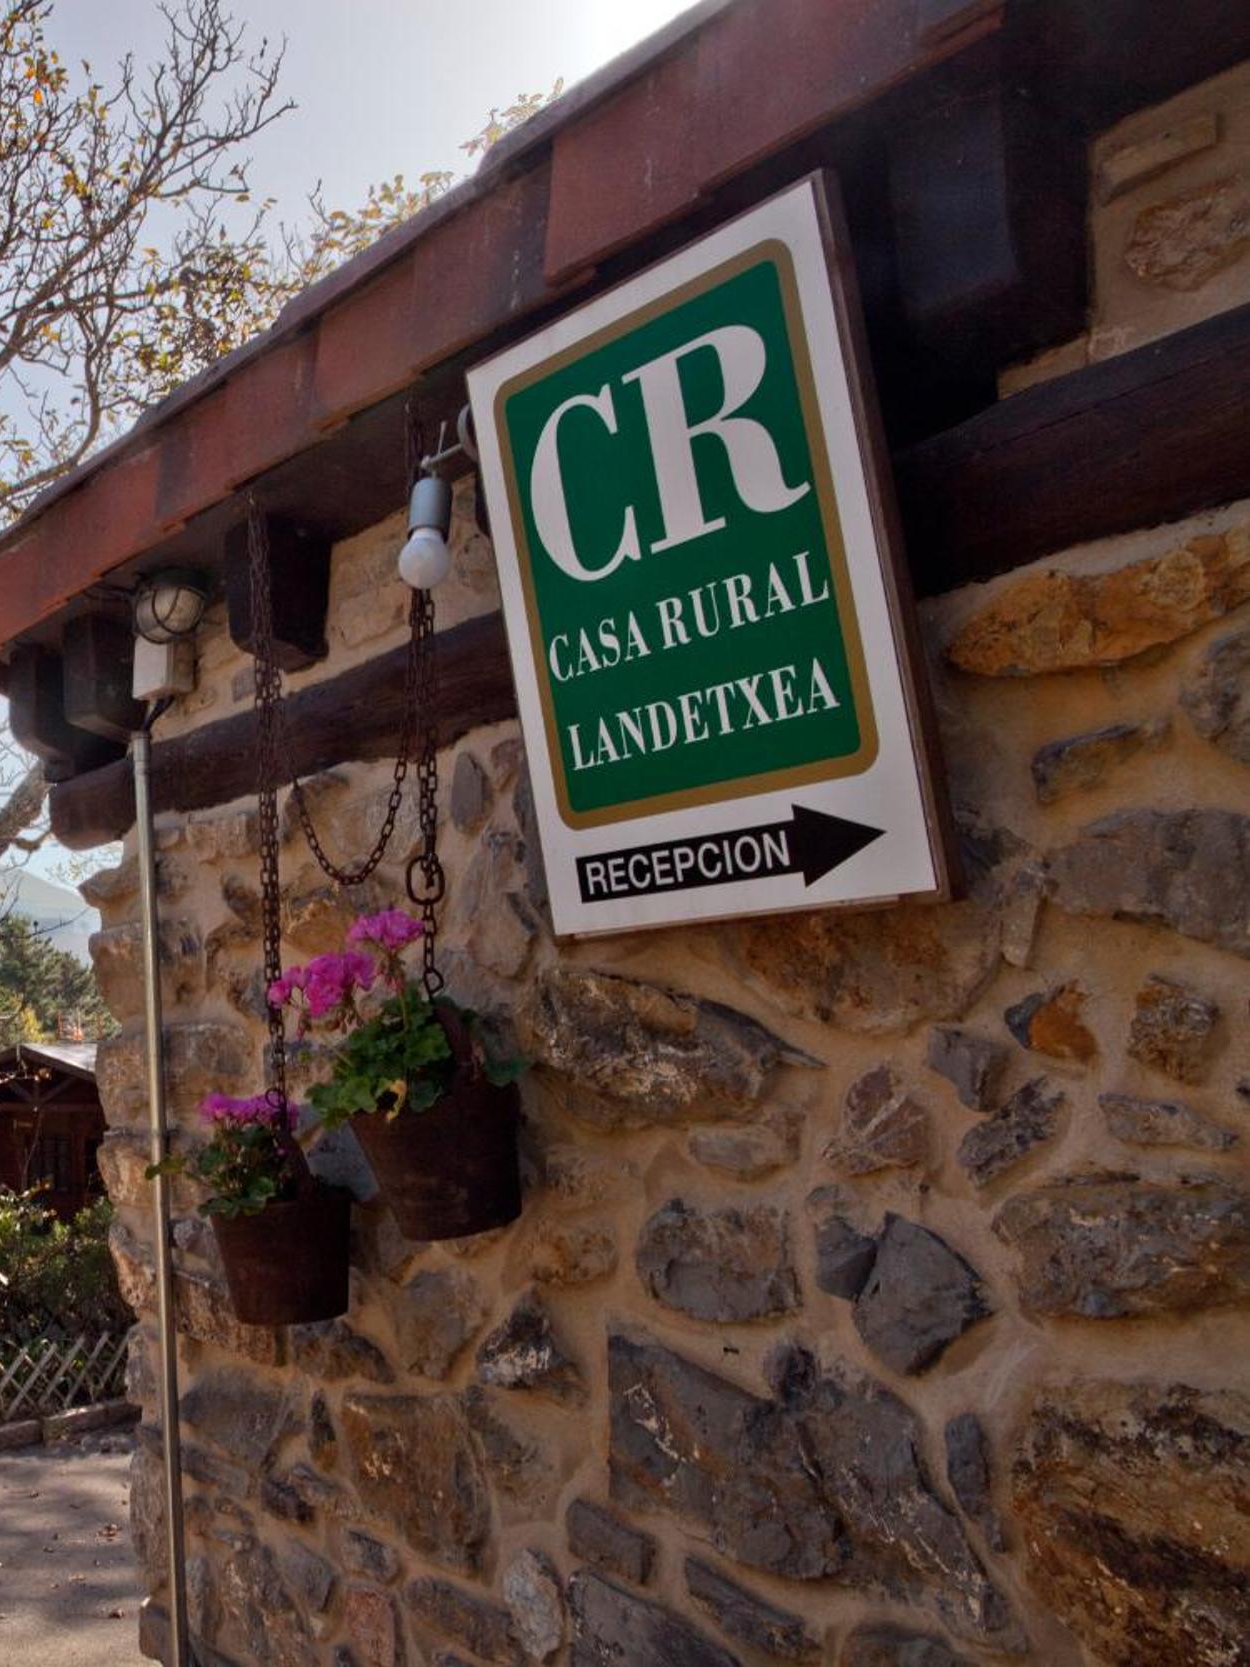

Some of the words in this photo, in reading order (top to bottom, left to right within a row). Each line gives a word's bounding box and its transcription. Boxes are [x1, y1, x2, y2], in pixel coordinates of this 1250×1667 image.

[530, 324, 812, 582] CR
[549, 611, 651, 682] CASA
[656, 551, 830, 649] RURAL
[568, 657, 840, 771] LANDETXEA
[586, 831, 791, 895] RECEPCION
